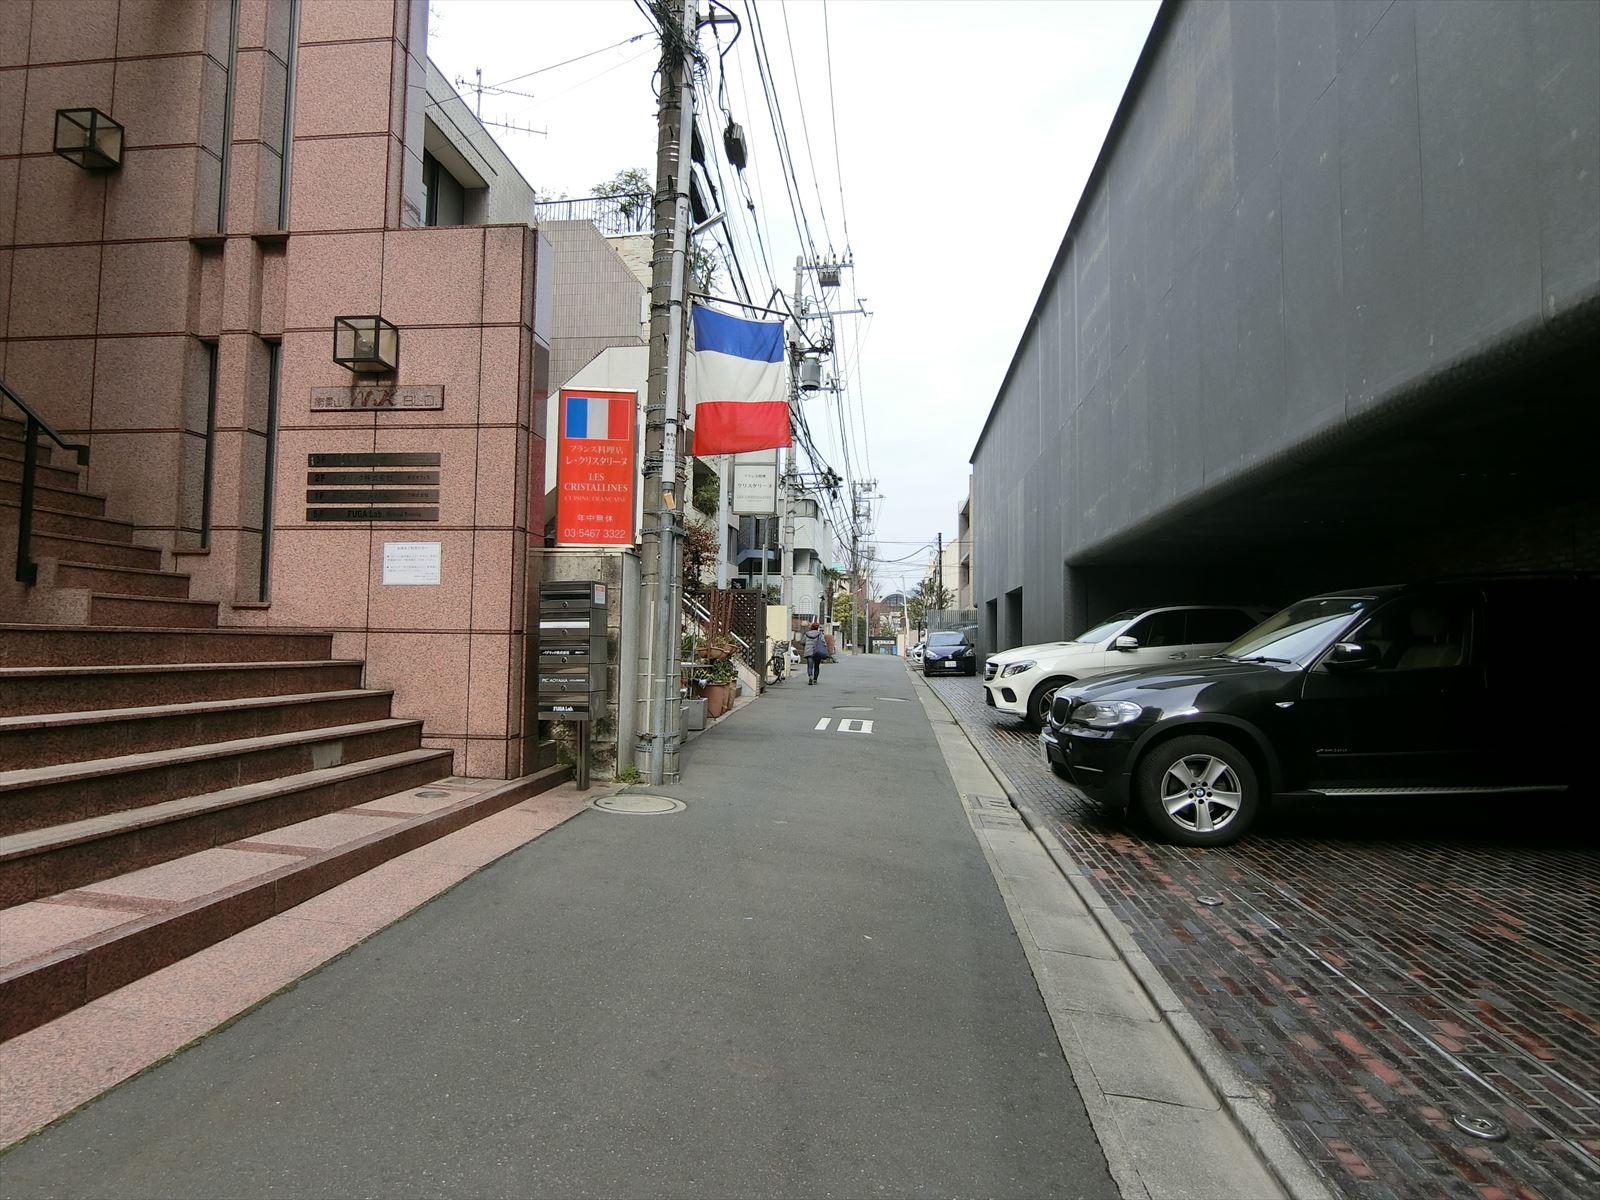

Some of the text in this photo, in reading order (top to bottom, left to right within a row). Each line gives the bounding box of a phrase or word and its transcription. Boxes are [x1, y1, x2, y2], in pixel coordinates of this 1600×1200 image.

[570, 445, 624, 455] フランス料理店
[566, 456, 628, 466] レ・クリスタリーヌ
[314, 473, 326, 483] 2F
[588, 472, 605, 481] LES
[564, 482, 629, 493] CRISTALLINES
[577, 513, 614, 523] 年中無休
[578, 528, 601, 538] 5467
[603, 529, 626, 539] 3322
